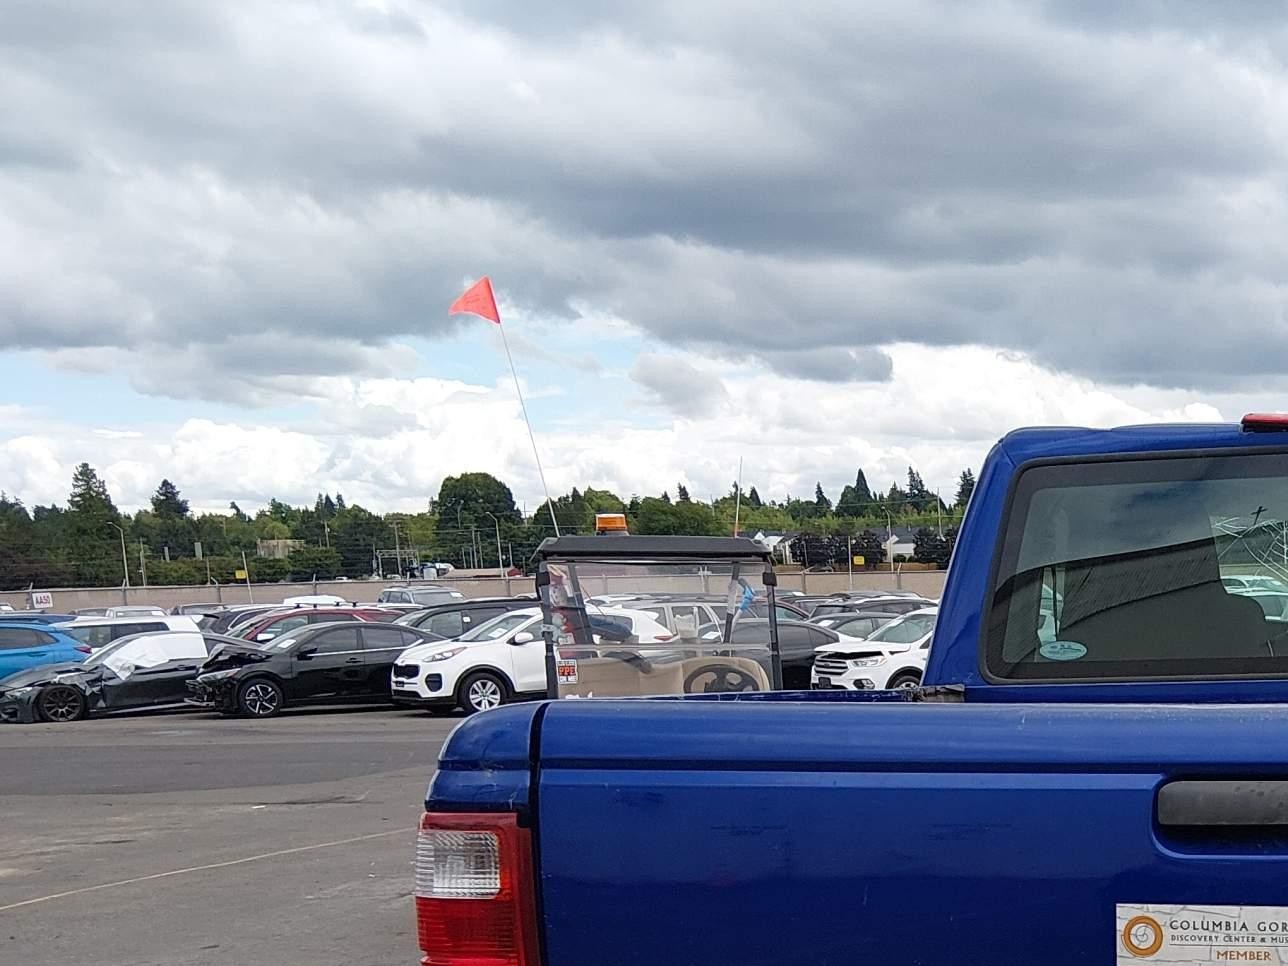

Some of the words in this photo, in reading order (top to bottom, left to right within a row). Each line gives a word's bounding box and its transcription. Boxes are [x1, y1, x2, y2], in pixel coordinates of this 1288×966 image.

[1169, 920, 1248, 931] COLUMBIA
[1171, 935, 1219, 943] DISCOVERY
[1223, 935, 1257, 943] CENTER
[1216, 950, 1272, 961] MEMBER
